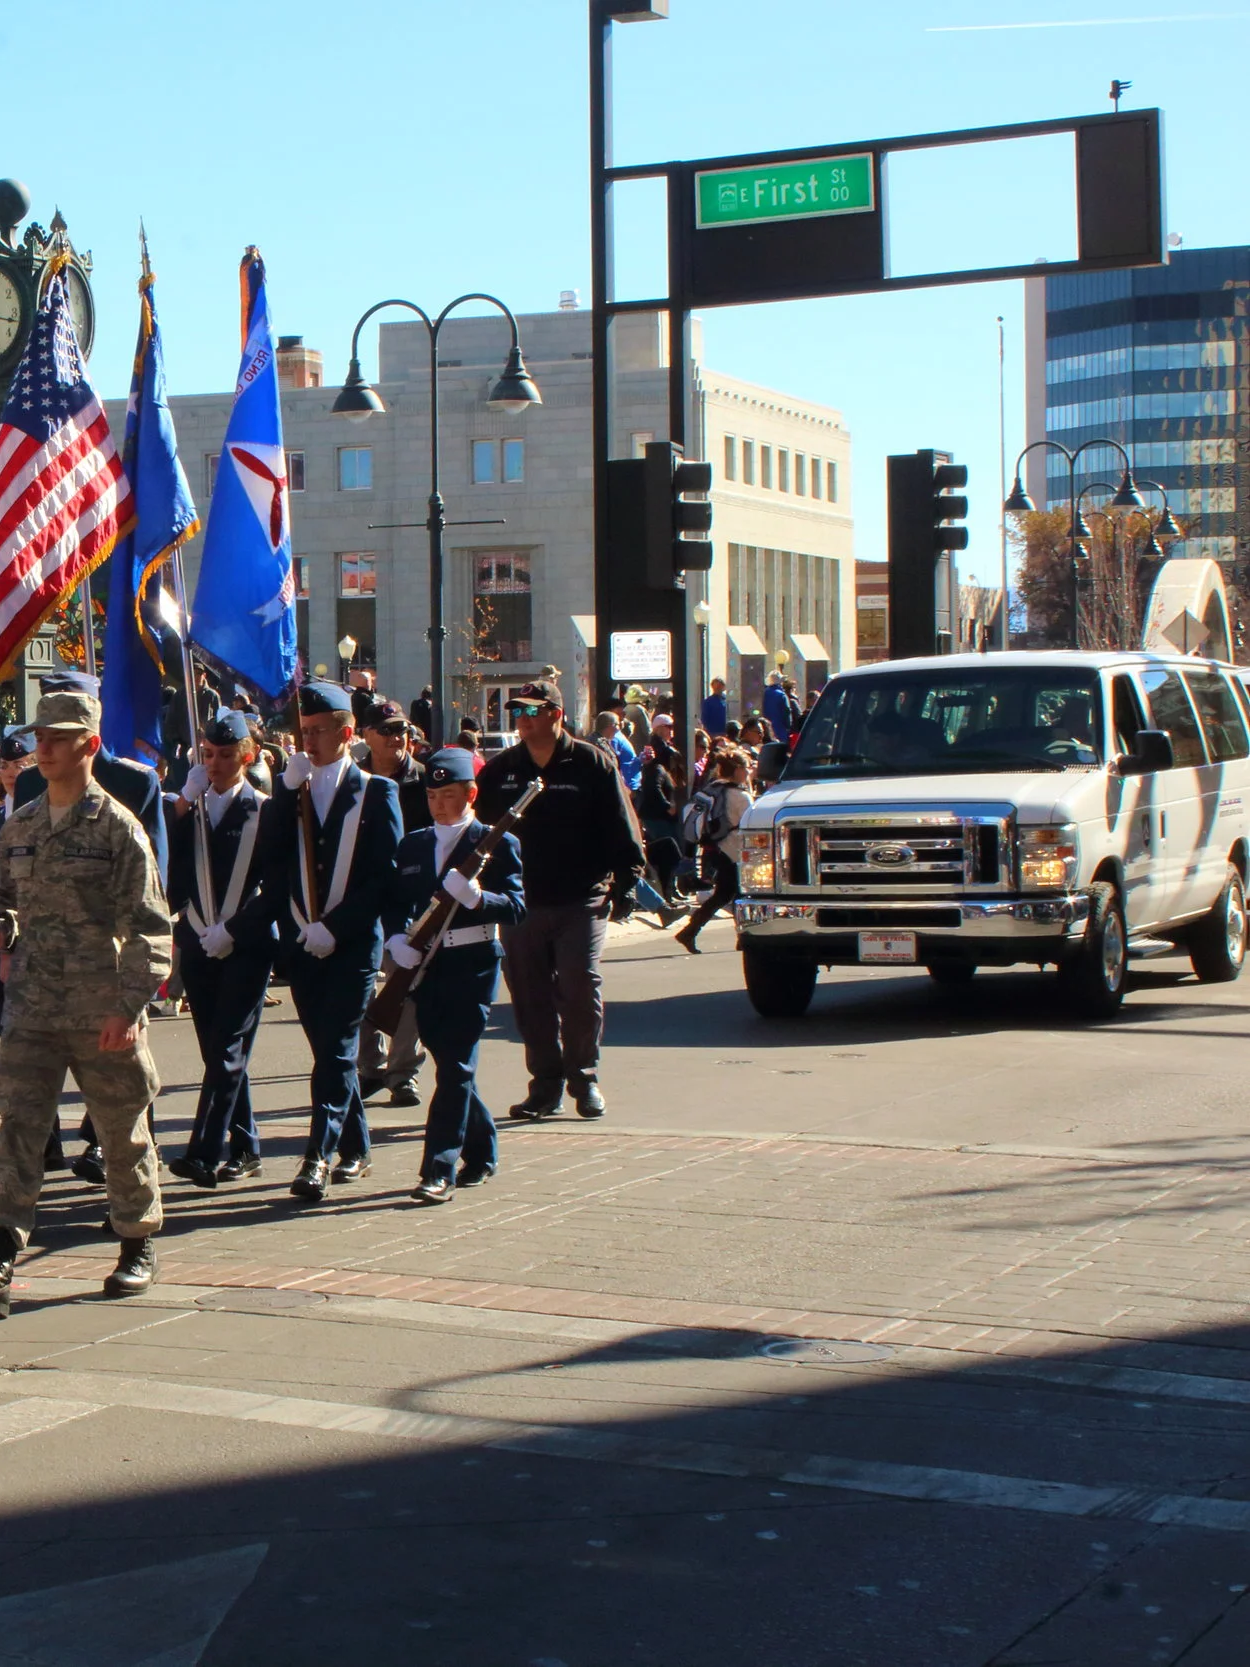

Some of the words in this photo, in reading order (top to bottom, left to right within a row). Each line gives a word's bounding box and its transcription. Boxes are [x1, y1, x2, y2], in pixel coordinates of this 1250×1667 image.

[740, 188, 749, 203] E
[754, 174, 819, 208] First
[831, 168, 847, 184] St
[5, 288, 12, 300] 2
[11, 307, 18, 318] 3
